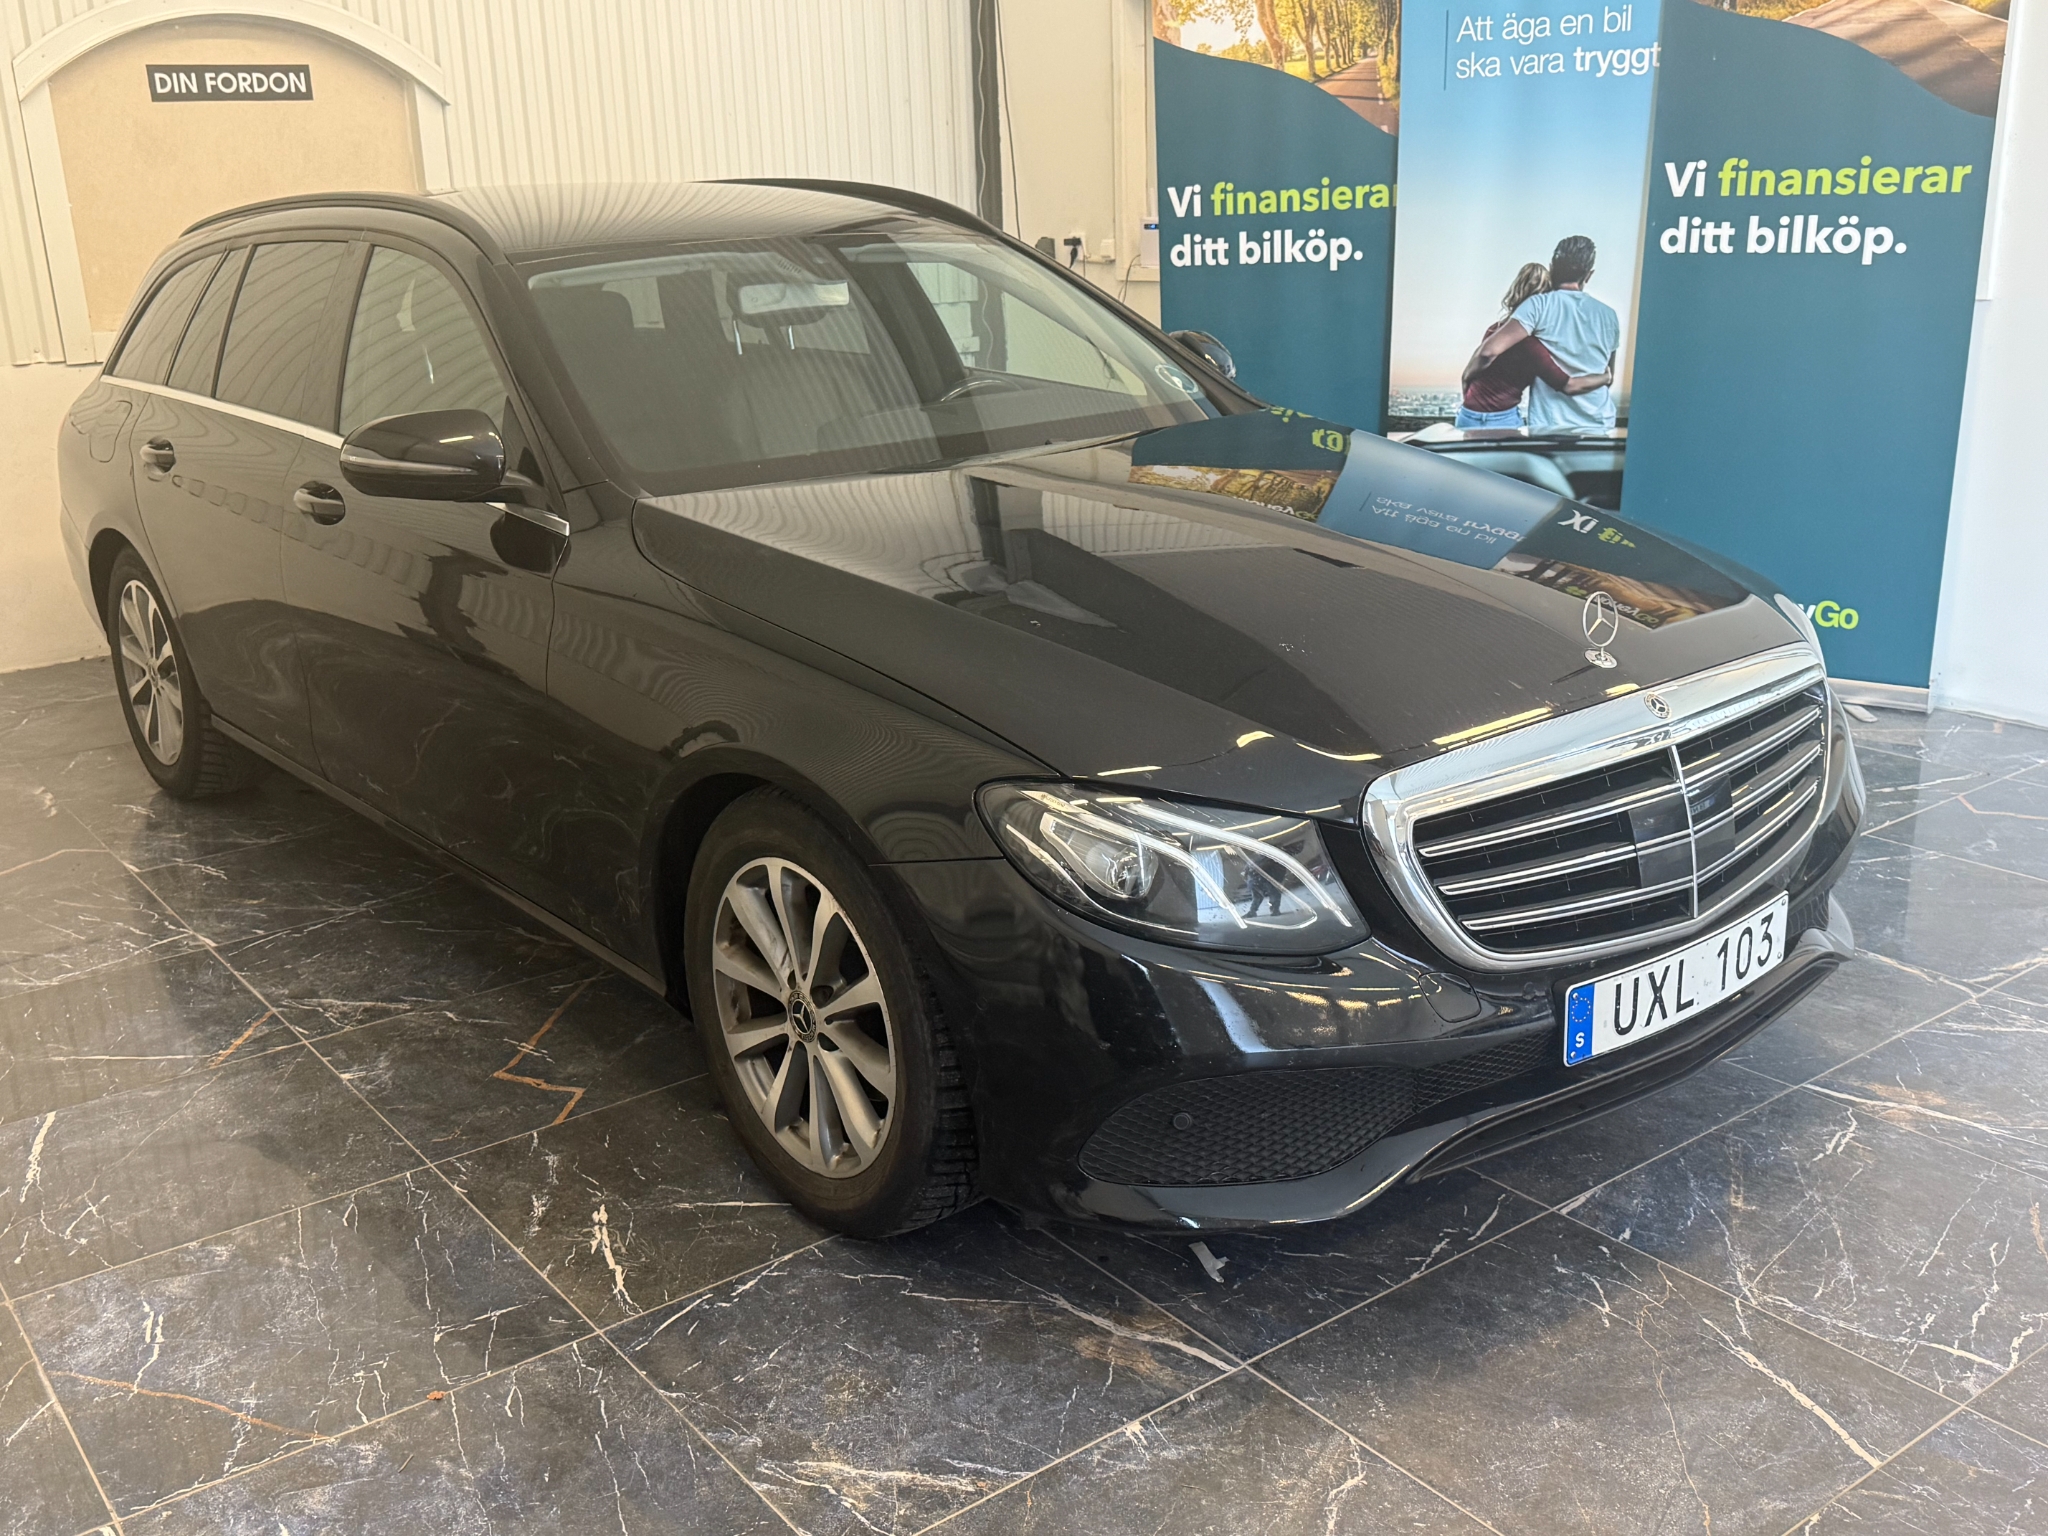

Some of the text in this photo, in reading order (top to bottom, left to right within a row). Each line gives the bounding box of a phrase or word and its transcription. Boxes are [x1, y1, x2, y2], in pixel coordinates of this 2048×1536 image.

[1456, 4, 1633, 45] Att äga en bil
[1455, 41, 1661, 79] ska vara tryggt
[154, 72, 307, 94] DIN FORDON
[1664, 155, 1973, 198] Vi finansierar
[1167, 184, 1201, 218] Vi
[1170, 228, 1364, 271] ditt bilköp.
[1659, 214, 1908, 266] ditt bilköp.
[1613, 911, 1774, 1036] UXL 103
[1575, 1032, 1585, 1048] S
